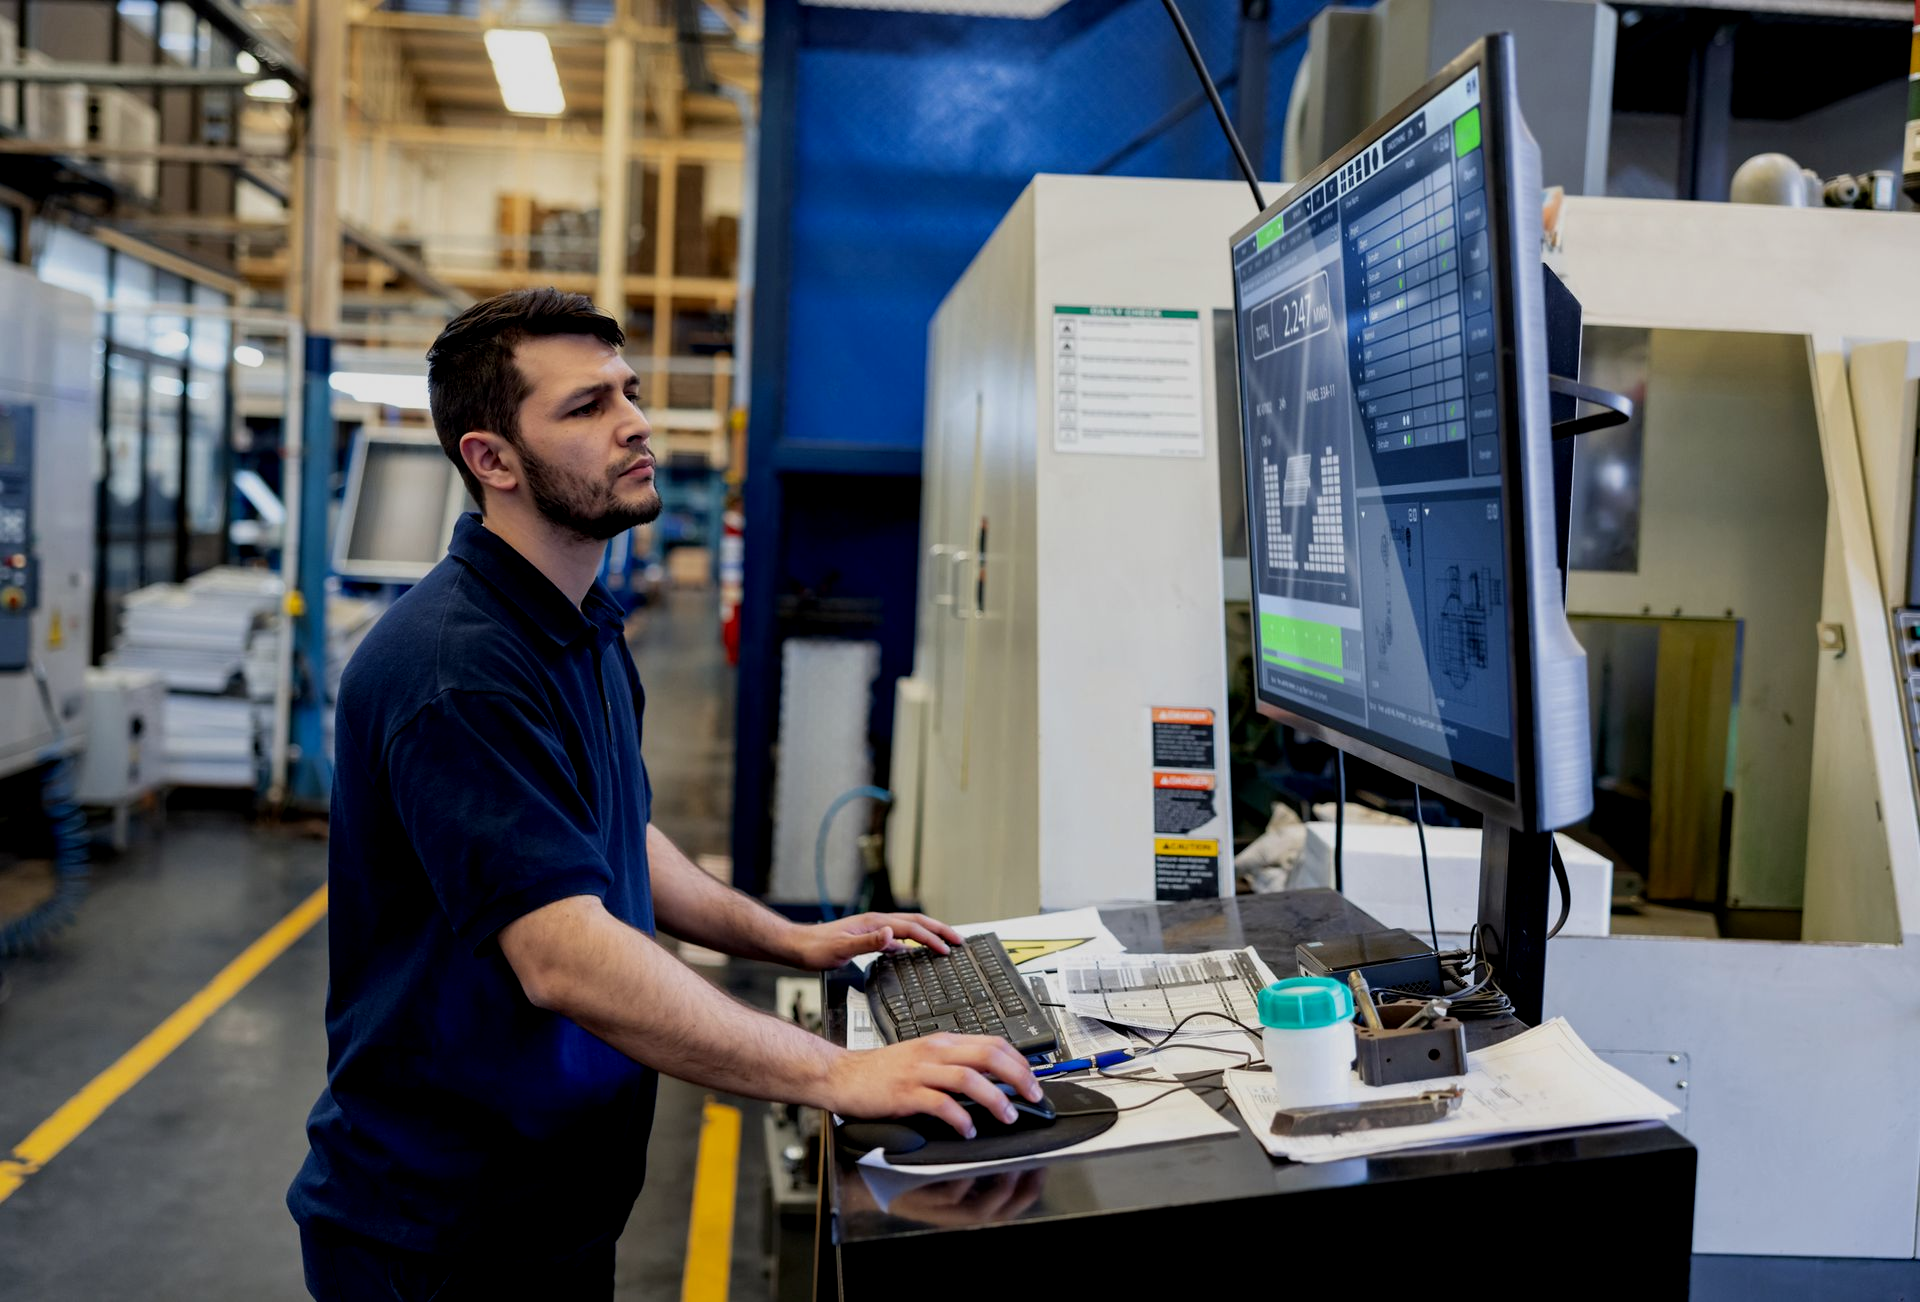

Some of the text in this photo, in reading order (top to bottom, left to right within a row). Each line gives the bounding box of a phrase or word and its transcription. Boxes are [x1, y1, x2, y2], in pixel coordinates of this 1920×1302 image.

[1255, 294, 1328, 341] TOTAL 2.247 MWh
[1306, 390, 1320, 403] PANEL
